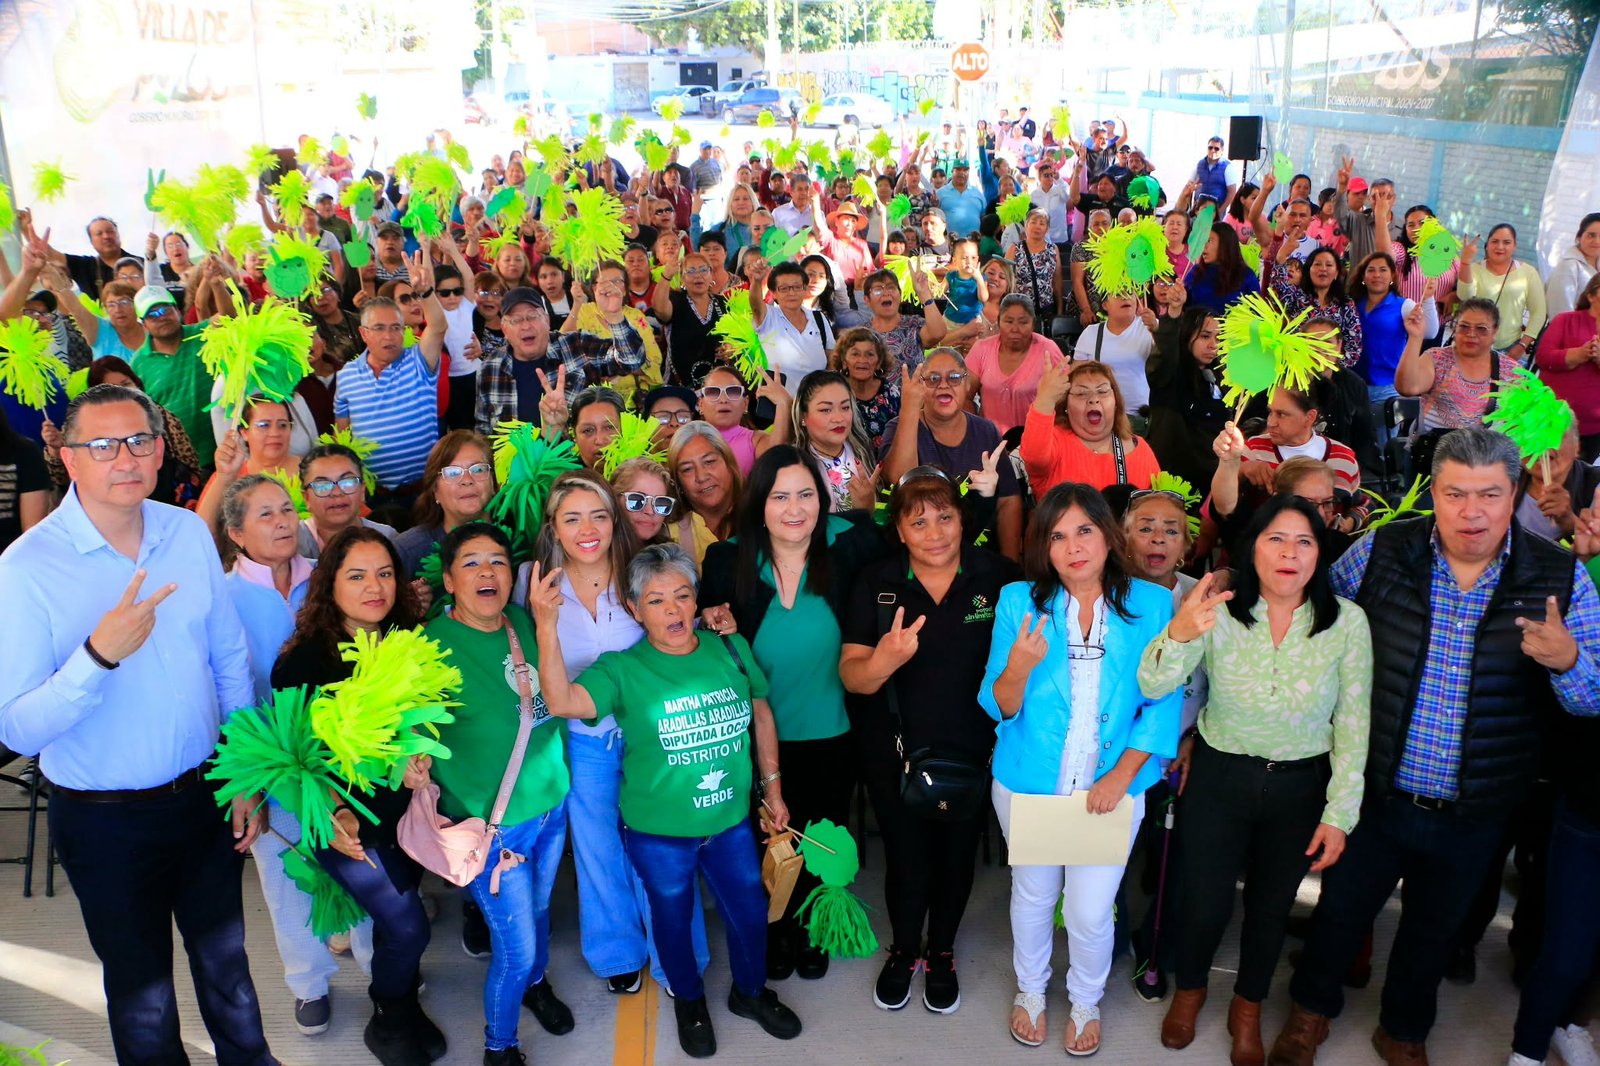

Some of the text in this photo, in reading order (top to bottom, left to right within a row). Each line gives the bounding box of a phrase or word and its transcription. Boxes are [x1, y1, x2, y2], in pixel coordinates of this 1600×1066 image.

[953, 52, 988, 71] ALTO
[664, 687, 739, 714] MARTHA PATRICIA
[657, 700, 750, 734] ARADILLAS ARADILLAS
[661, 729, 718, 749] DIPUTADA
[667, 743, 730, 766] DISTRITO
[692, 787, 734, 809] VERDE
